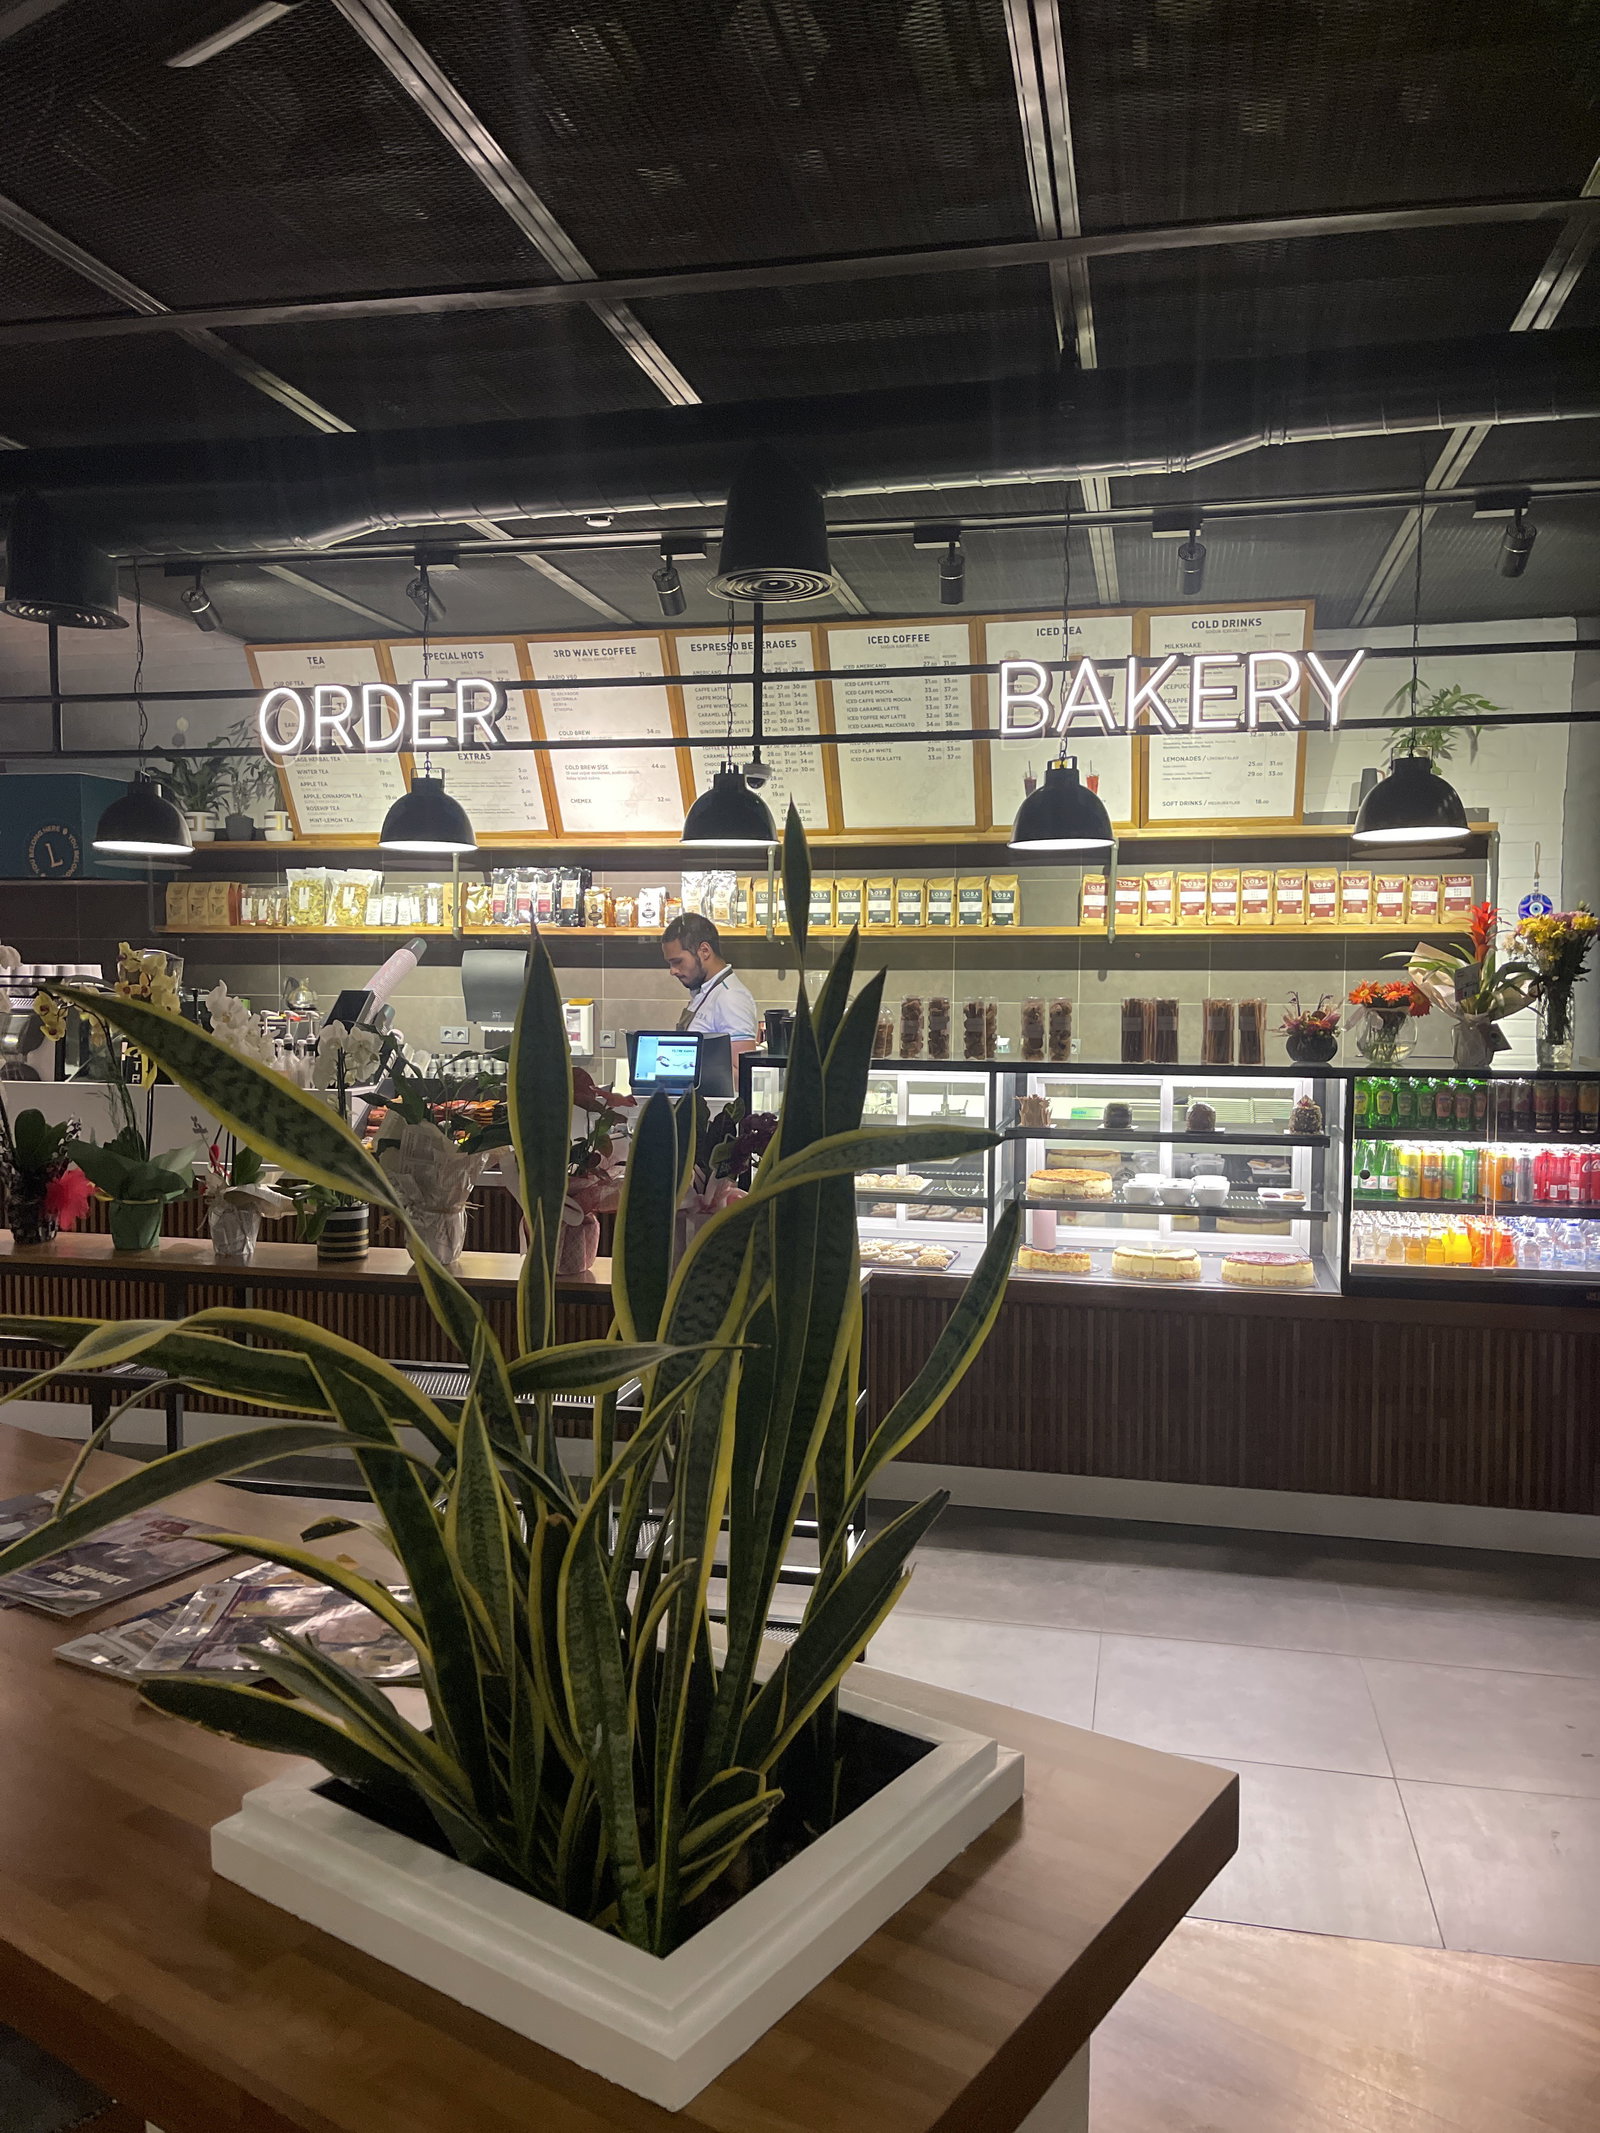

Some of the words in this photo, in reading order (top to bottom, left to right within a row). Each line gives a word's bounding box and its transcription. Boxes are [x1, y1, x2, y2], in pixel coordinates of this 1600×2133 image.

[1191, 620, 1219, 630] COLD
[1221, 618, 1262, 628] DRINKS
[1036, 627, 1060, 637] ICED
[1062, 626, 1083, 635] TEA
[867, 635, 890, 645] ICED
[893, 633, 930, 643] COFFEE
[554, 649, 571, 658] 3RD
[573, 648, 599, 657] WAVE
[601, 646, 637, 656] COFFEE
[690, 642, 739, 652] ESPRESSO
[741, 640, 797, 650] BEERAGES
[307, 656, 325, 665] TEA
[423, 652, 459, 661] SPECIAL
[461, 651, 485, 660] HOTS
[1000, 650, 1365, 735] BAKERY
[259, 678, 504, 753] ORDER
[457, 752, 491, 761] EXTRAS
[42, 825, 61, 833] HERE
[45, 842, 64, 868] L
